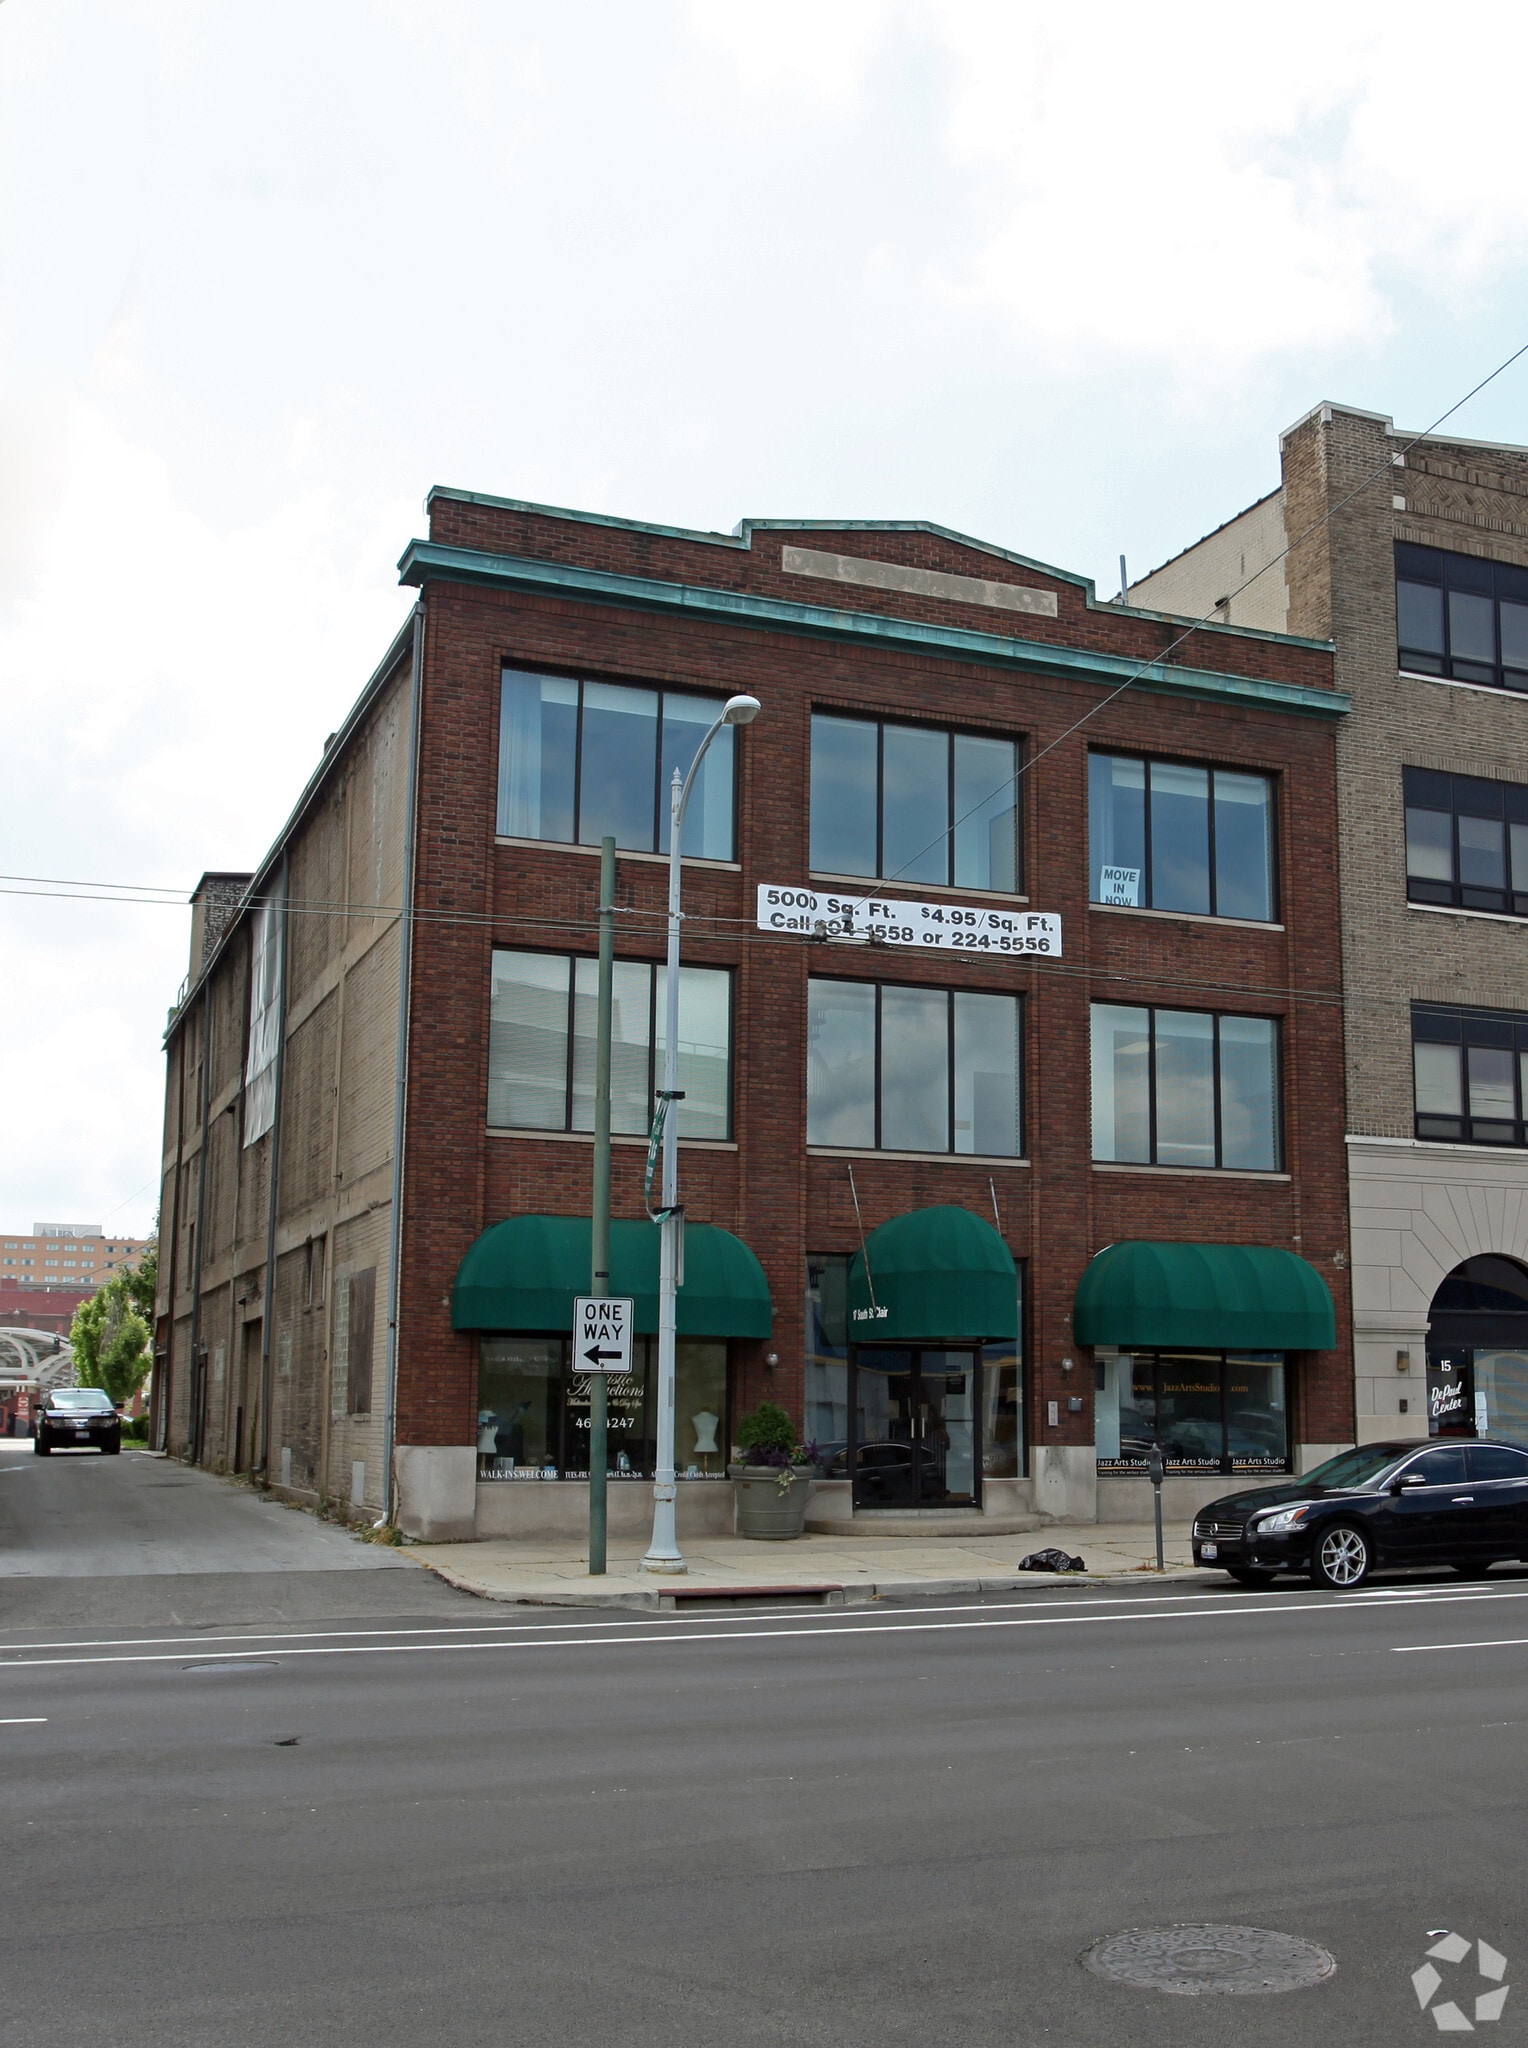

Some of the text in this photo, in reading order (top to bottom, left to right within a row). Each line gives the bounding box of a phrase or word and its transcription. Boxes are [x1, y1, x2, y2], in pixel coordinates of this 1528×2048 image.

[1104, 869, 1137, 882] MOVE
[1113, 883, 1125, 894] IN
[1105, 895, 1132, 906] NOW
[767, 890, 818, 911] 5000
[827, 899, 860, 918] Sq.
[869, 903, 896, 919] Ft.
[1027, 917, 1054, 932] Ft.
[770, 912, 810, 931] Call
[922, 932, 943, 944] or
[951, 931, 1051, 952] 224-5556
[585, 1304, 623, 1320] ONE
[584, 1324, 624, 1340] WAY
[1440, 1360, 1451, 1371] 15
[1432, 1398, 1462, 1416] Center
[1165, 1458, 1180, 1466] Jazz
[1247, 1457, 1262, 1465] Arts
[1263, 1457, 1285, 1465] Studio
